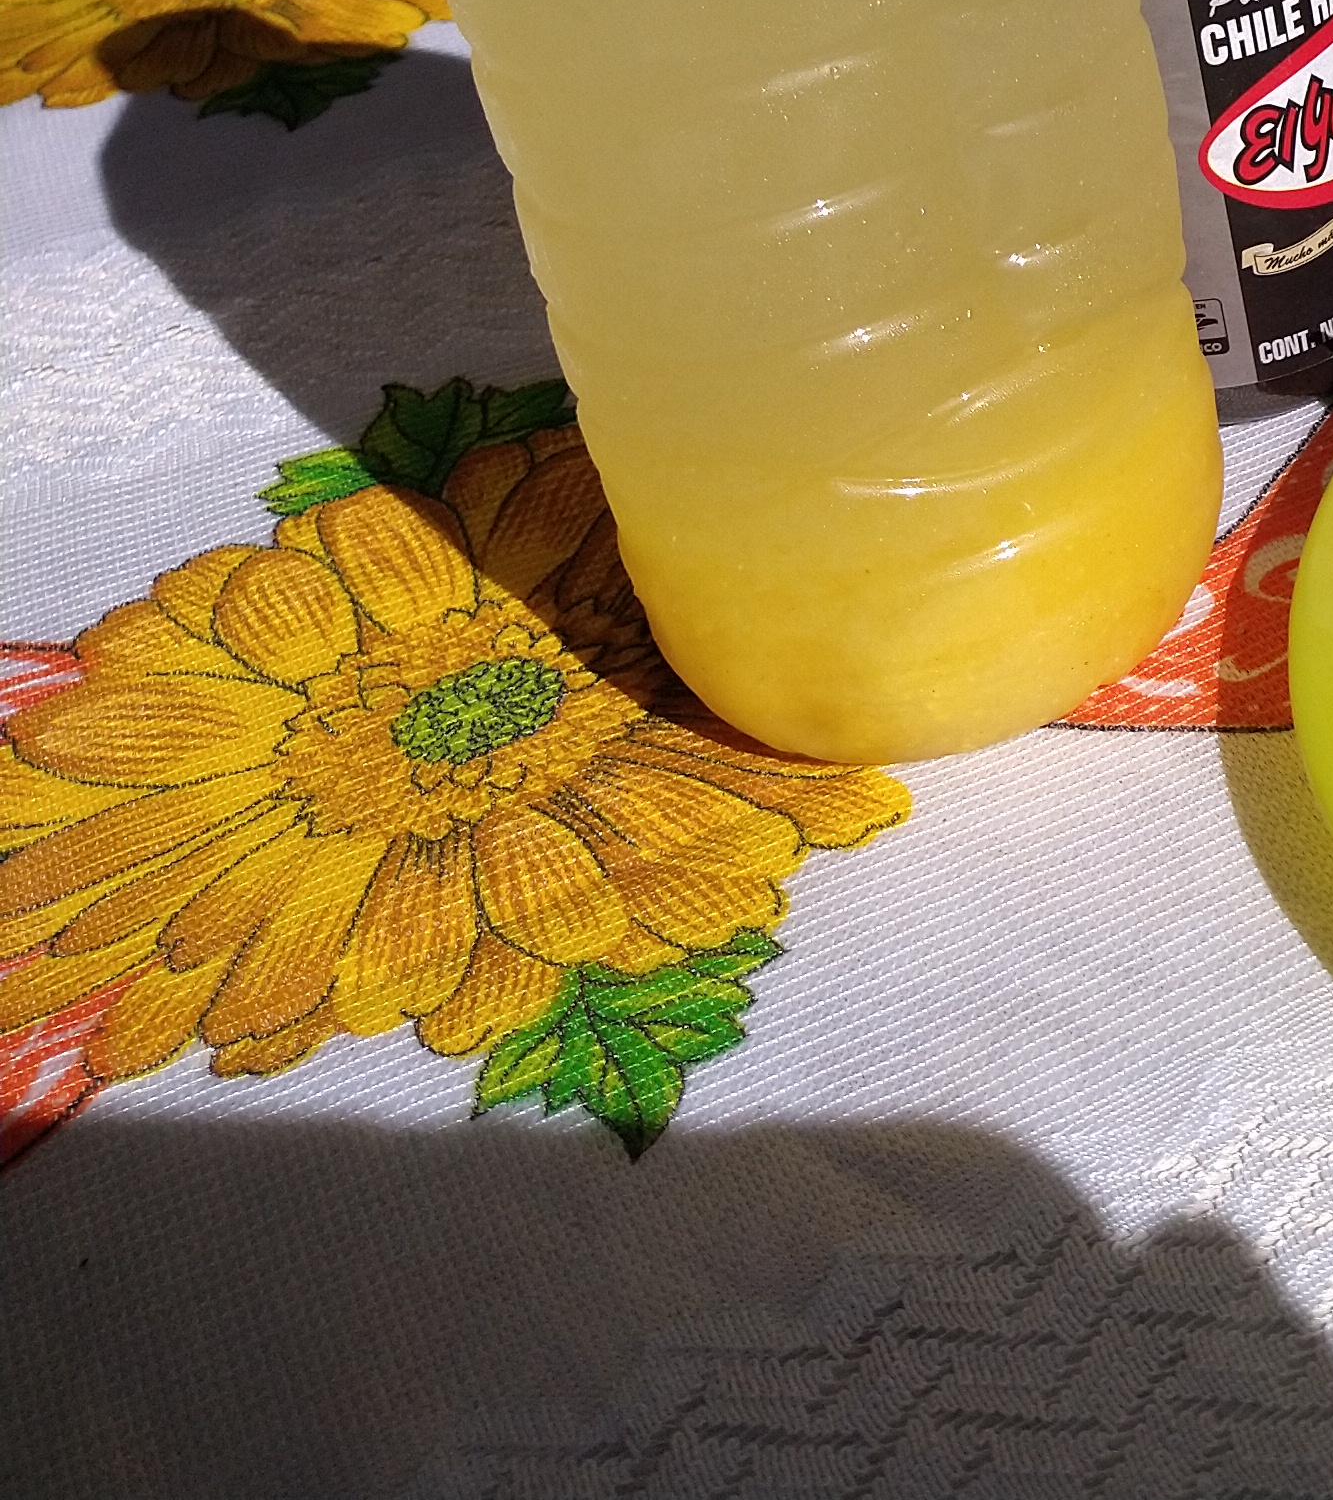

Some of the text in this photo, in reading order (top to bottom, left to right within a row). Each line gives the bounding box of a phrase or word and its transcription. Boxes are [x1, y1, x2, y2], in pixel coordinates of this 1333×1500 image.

[1233, 98, 1300, 186] El
[1264, 246, 1314, 271] Mucho
[1258, 329, 1316, 365] CONT.
